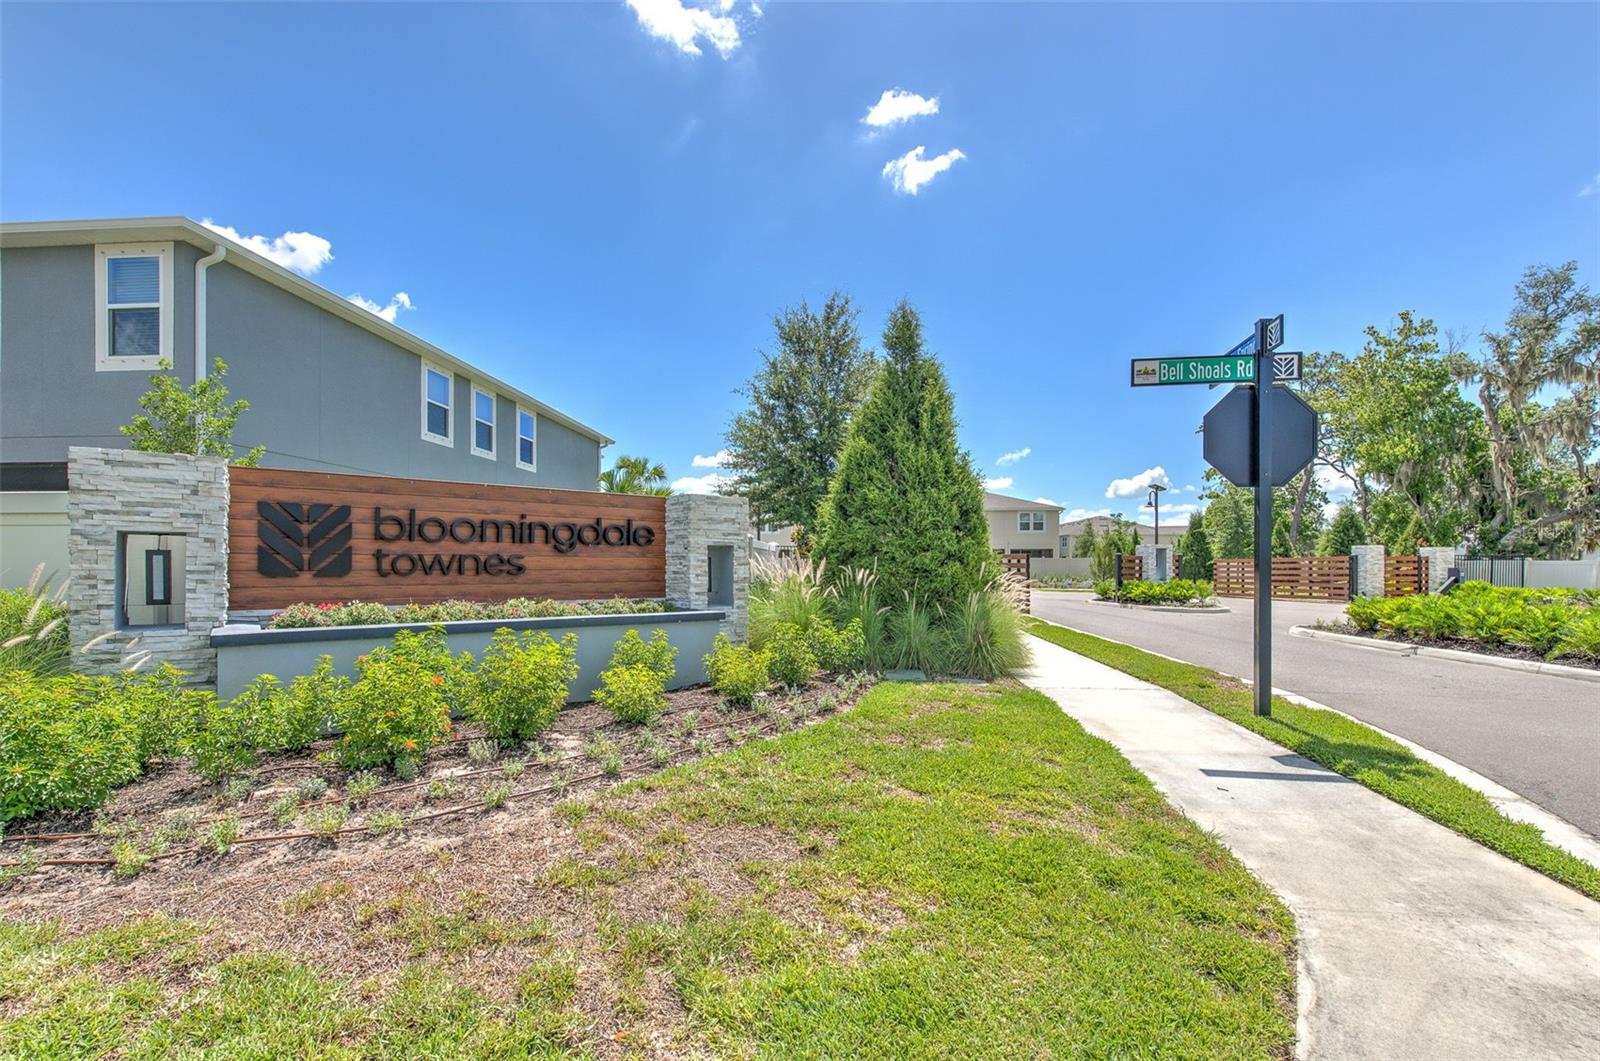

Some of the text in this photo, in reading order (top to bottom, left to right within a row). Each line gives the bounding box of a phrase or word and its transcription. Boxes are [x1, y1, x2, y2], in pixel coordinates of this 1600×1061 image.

[1161, 359, 1253, 381] Bell Shoals Rd
[375, 507, 655, 553] bloomingdale
[374, 549, 527, 577] townes
